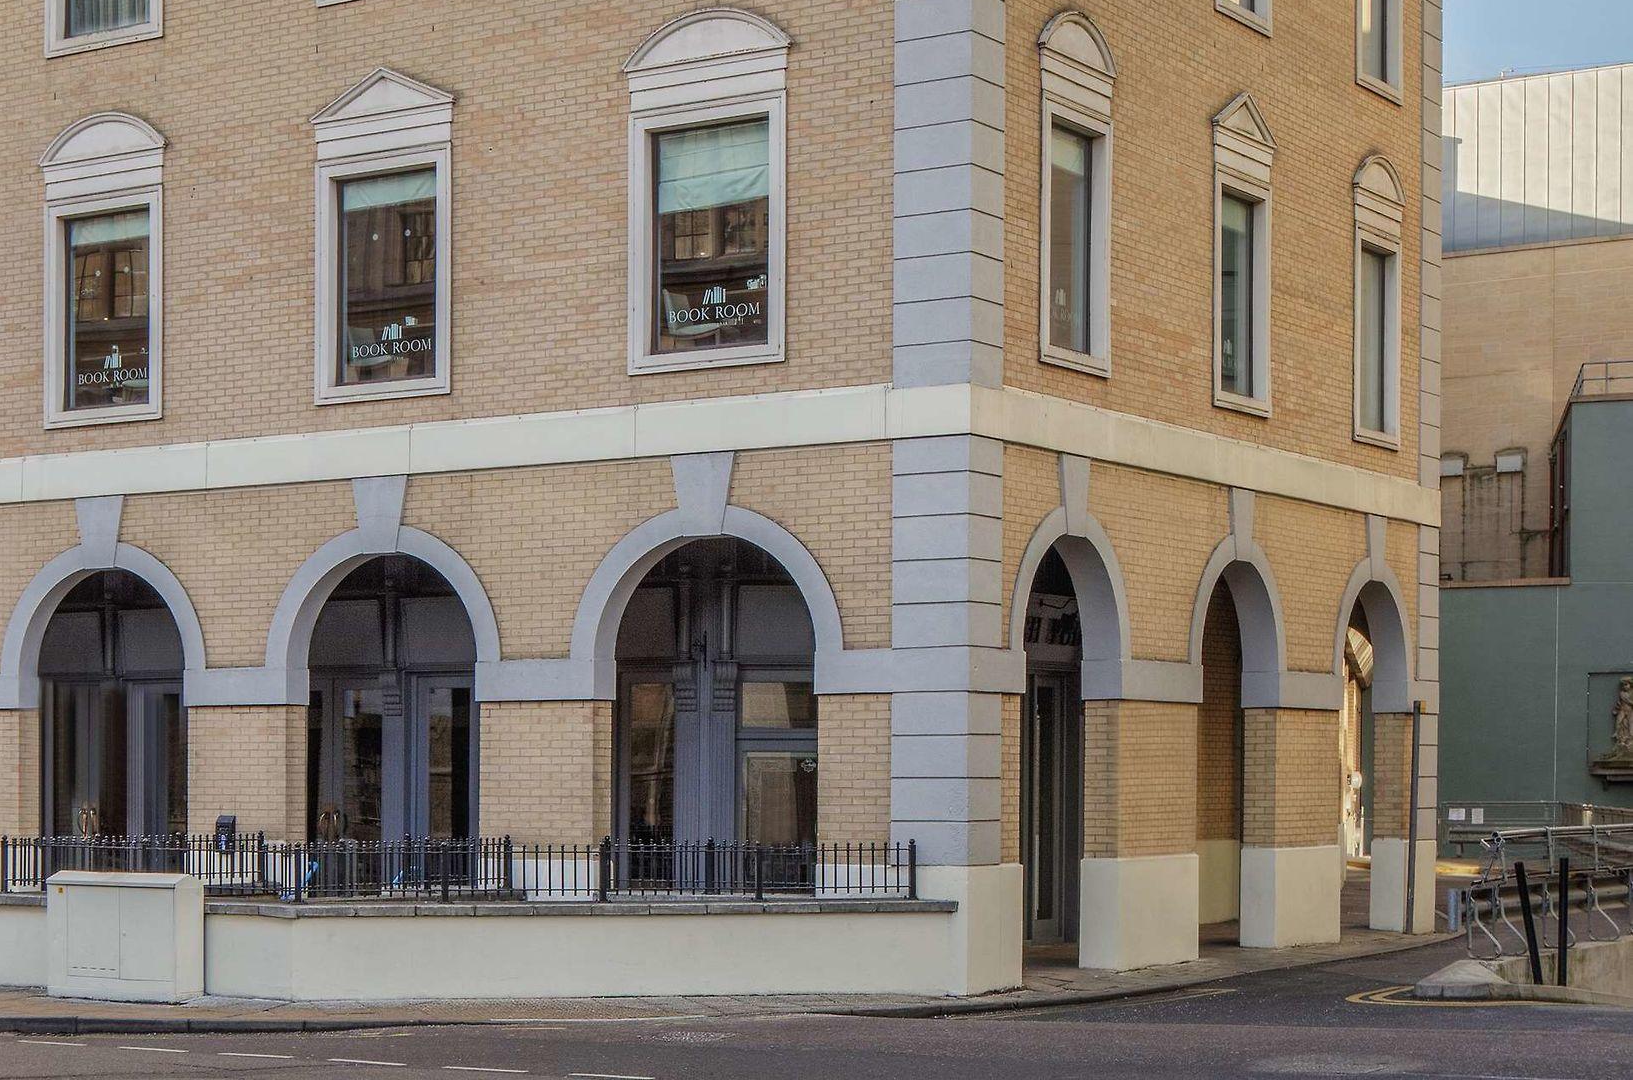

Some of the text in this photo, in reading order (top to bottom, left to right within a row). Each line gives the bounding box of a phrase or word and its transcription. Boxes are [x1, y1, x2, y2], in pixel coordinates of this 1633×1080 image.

[669, 302, 760, 323] BOOK ROOM
[352, 338, 432, 358] BOOK ROOM
[78, 367, 148, 385] BOOK ROOM
